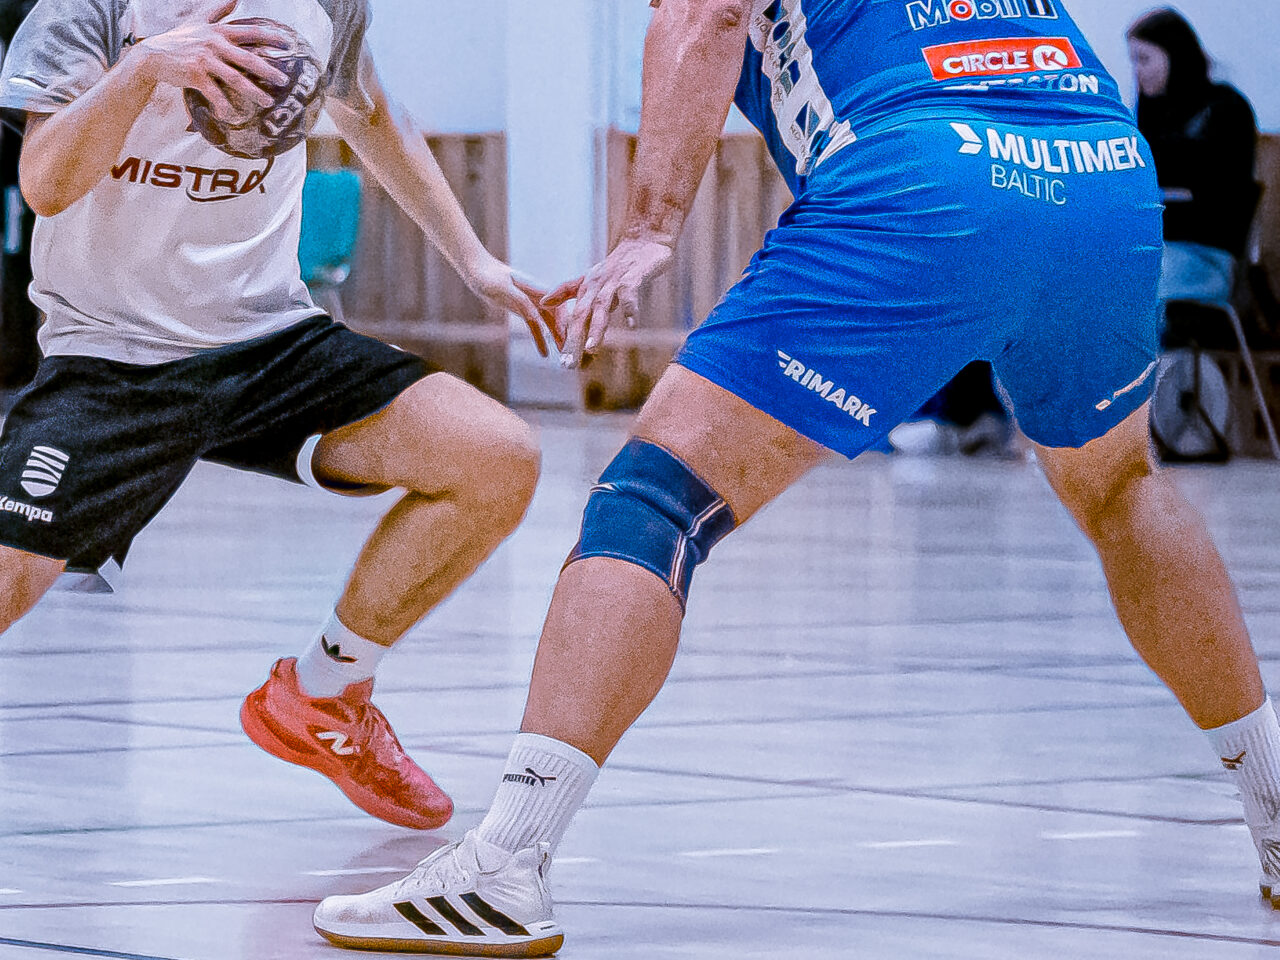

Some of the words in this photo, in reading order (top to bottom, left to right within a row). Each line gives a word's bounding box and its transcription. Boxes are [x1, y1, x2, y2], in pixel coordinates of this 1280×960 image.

[942, 51, 1031, 74] CIRCLE
[1032, 45, 1068, 71] K
[986, 128, 1147, 174] MULTIMEK
[111, 156, 267, 196] MISTRA
[990, 164, 1067, 206] BALTIC
